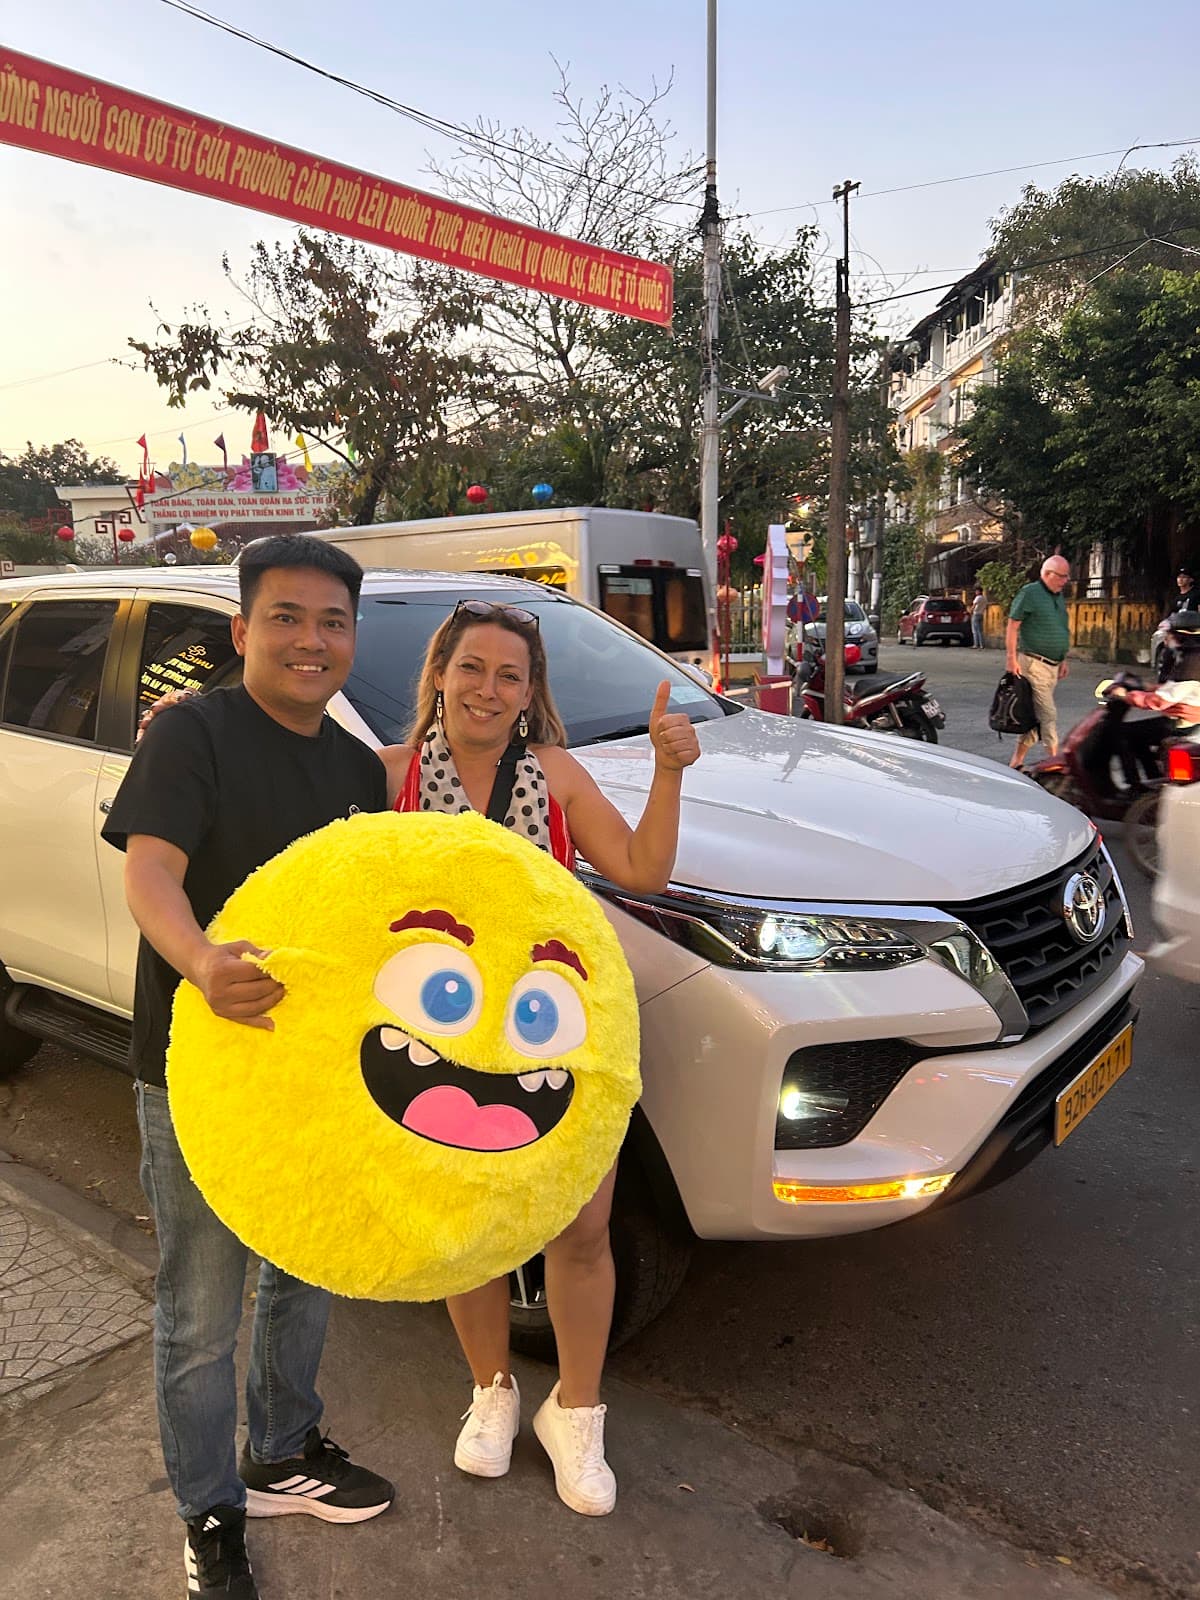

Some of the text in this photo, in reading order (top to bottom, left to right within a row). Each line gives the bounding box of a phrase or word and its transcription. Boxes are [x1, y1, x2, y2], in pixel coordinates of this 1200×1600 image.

[41, 86, 103, 146] NGƯỜI
[104, 105, 145, 157] CON
[144, 115, 172, 165] ƯU
[171, 120, 197, 171] TÚ
[195, 126, 231, 182] CỦA
[229, 145, 297, 201] PHƯỜNG
[357, 182, 389, 230] LÊN
[383, 193, 432, 243] ĐƯỜNG
[429, 209, 463, 258] THỰC
[460, 217, 492, 267] HIỆN
[489, 229, 523, 274] NGHĨA
[525, 240, 542, 284] VỤ
[540, 243, 571, 285] QUÂN
[588, 253, 610, 297] BẢO
[611, 263, 624, 308] VỆ
[624, 262, 639, 305] TỔ
[638, 270, 663, 312] QUỐC
[197, 497, 216, 506] TOÀN
[282, 497, 292, 505] RA
[275, 508, 294, 516] KINH
[1064, 1039, 1127, 1129] 92H-021.71
